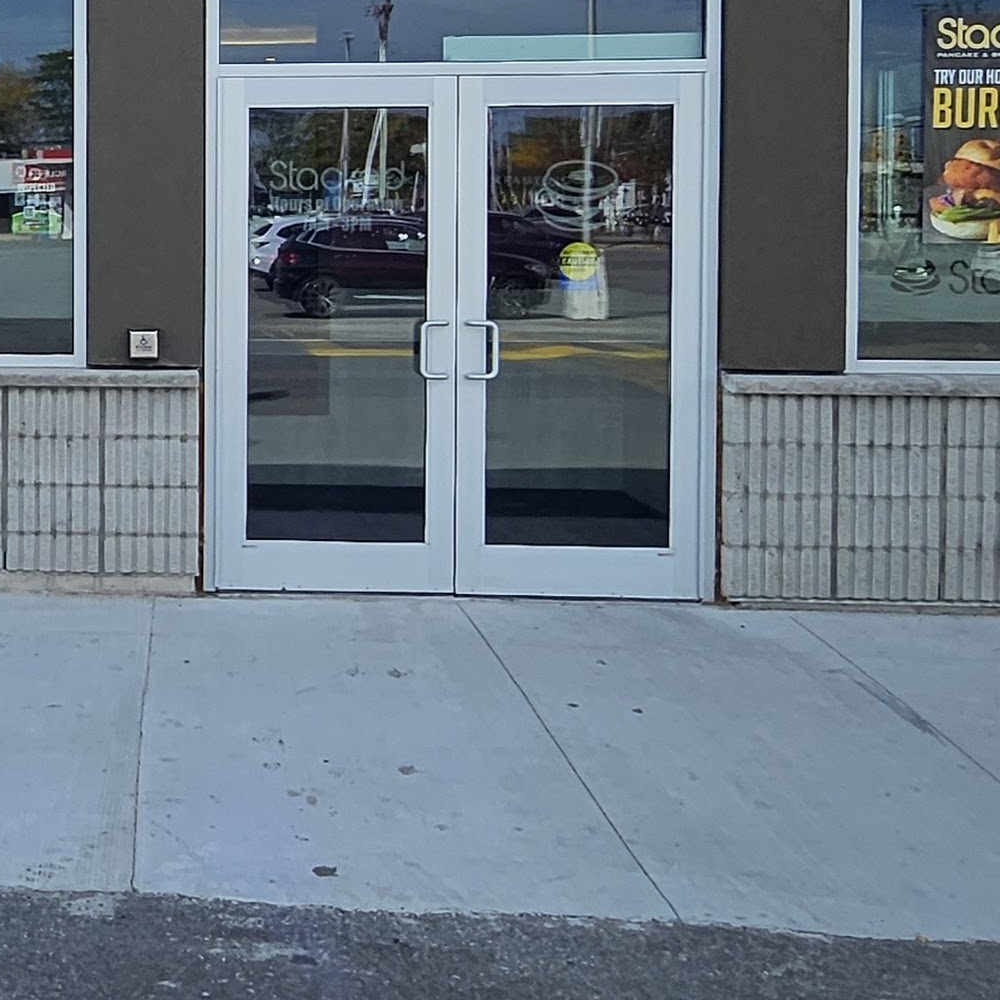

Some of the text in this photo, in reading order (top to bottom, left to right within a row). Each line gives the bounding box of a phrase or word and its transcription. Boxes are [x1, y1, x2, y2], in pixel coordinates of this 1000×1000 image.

[934, 69, 957, 85] TRY
[958, 69, 984, 85] OUR
[933, 87, 999, 129] BUR
[271, 197, 312, 212] Hours
